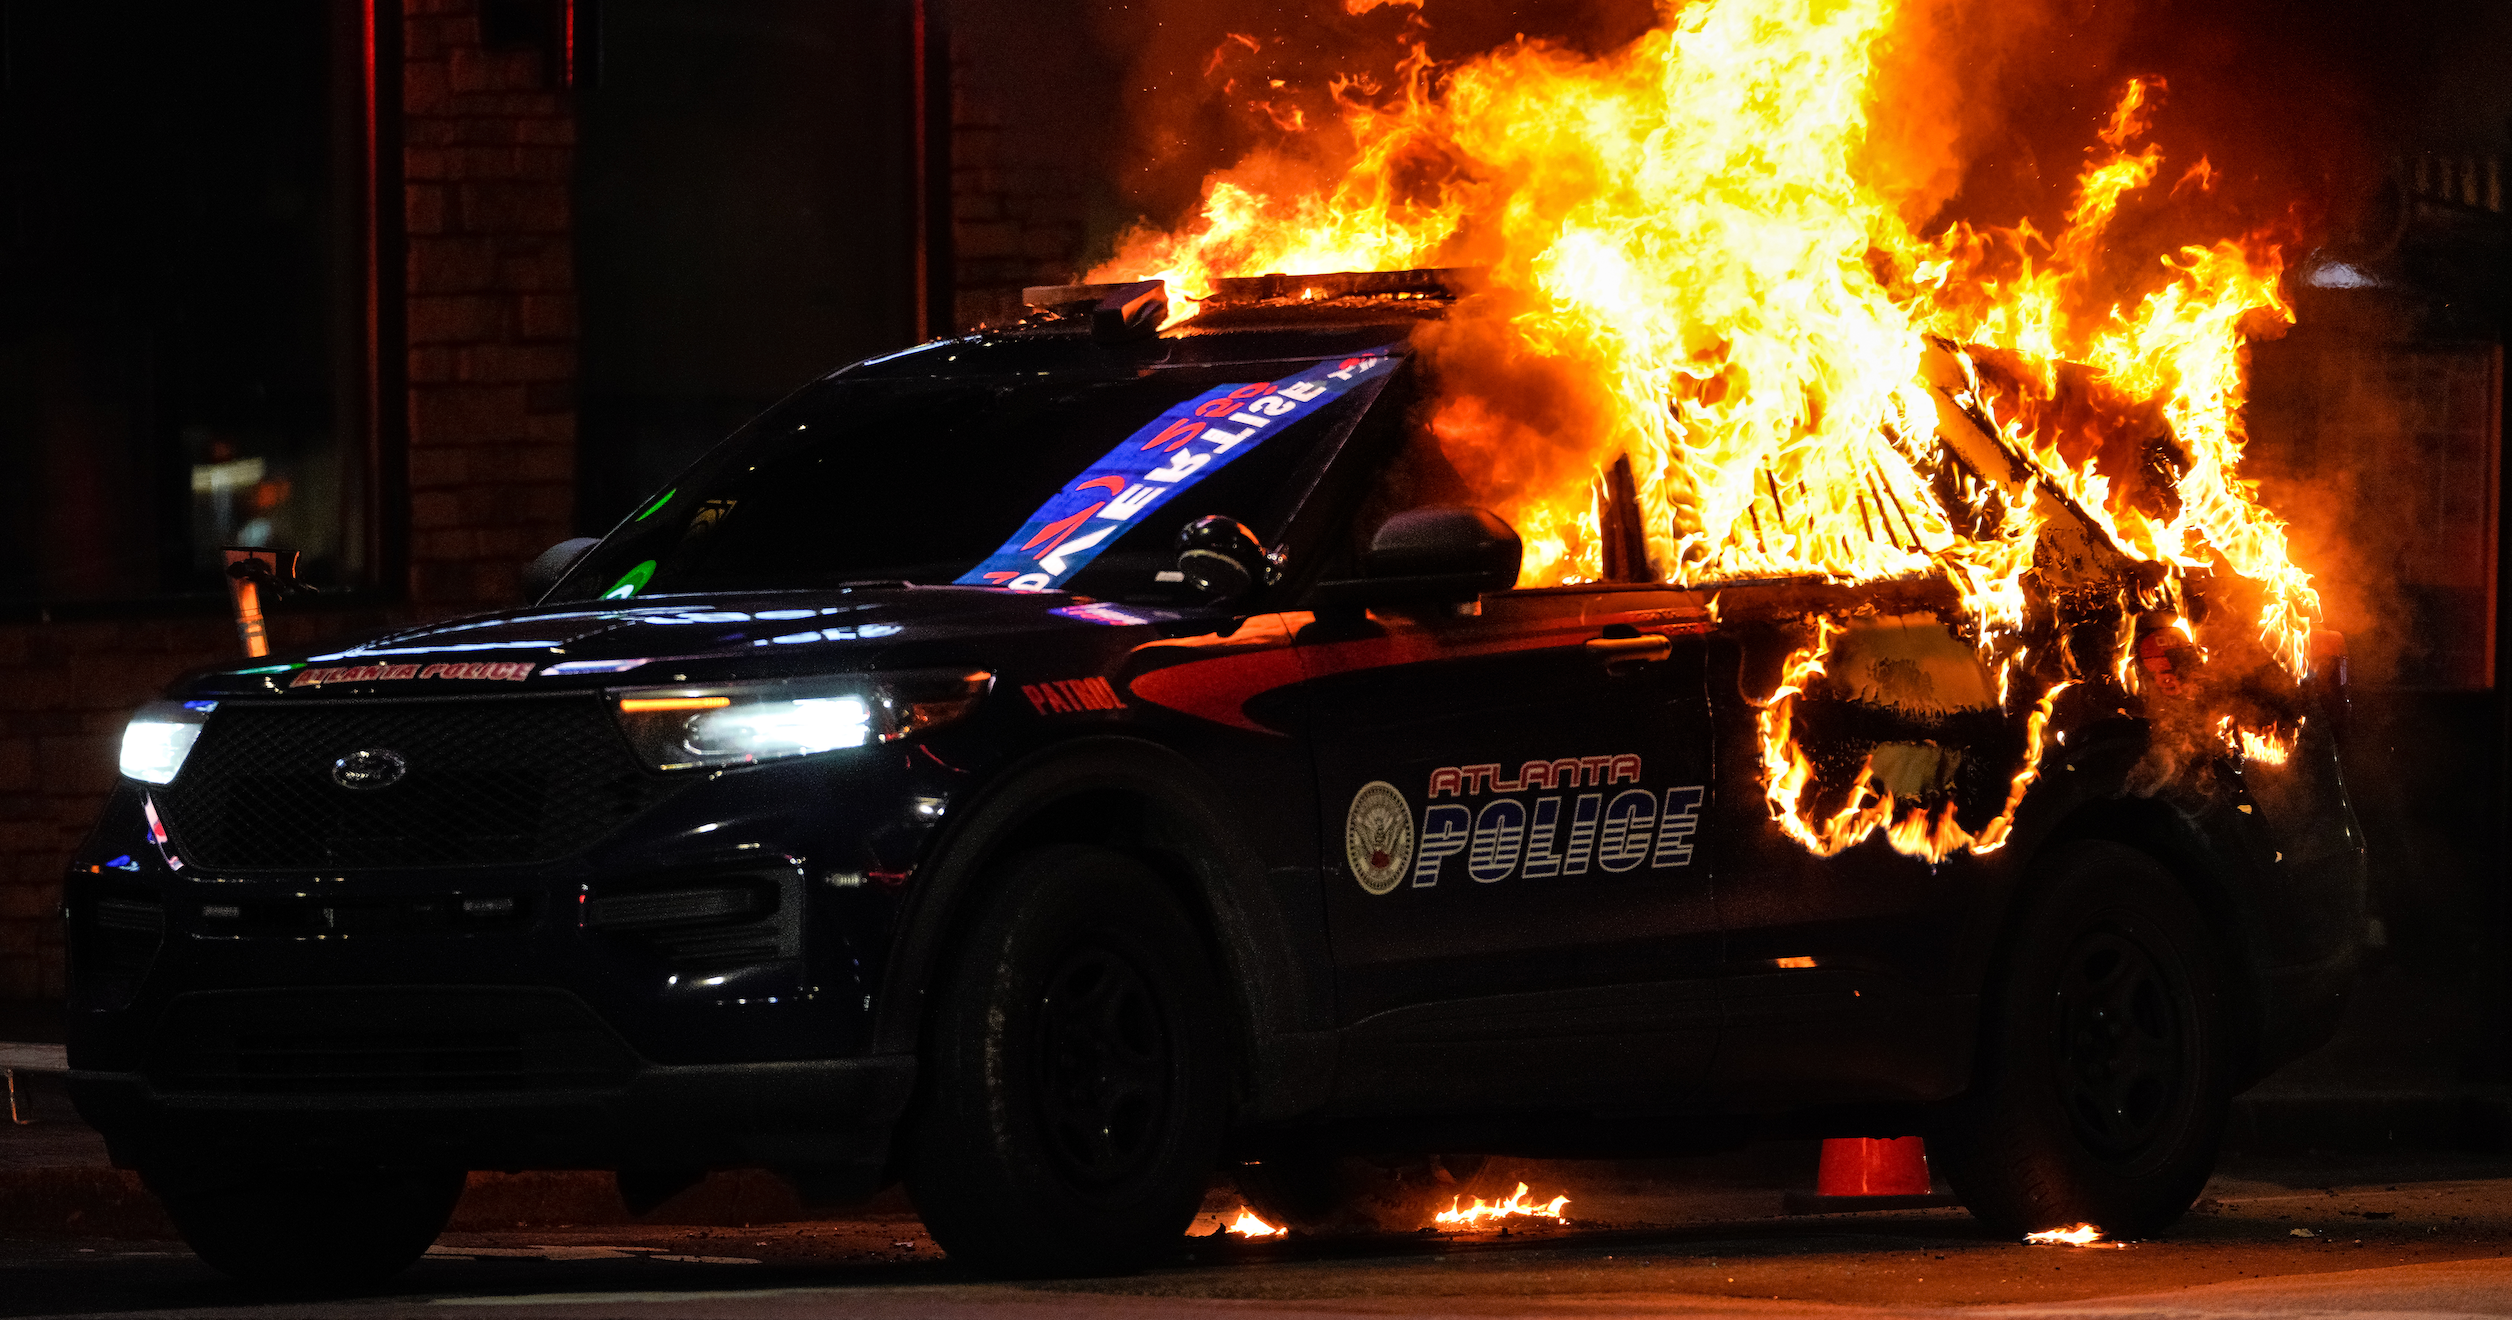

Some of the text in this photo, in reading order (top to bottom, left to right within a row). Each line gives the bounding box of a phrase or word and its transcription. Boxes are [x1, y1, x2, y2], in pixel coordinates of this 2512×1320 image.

[288, 661, 537, 689] ATLANTA POLICE
[1020, 675, 1129, 716] PATROL
[1427, 752, 1643, 800] ATLANTA
[1411, 784, 1705, 889] POLICE
